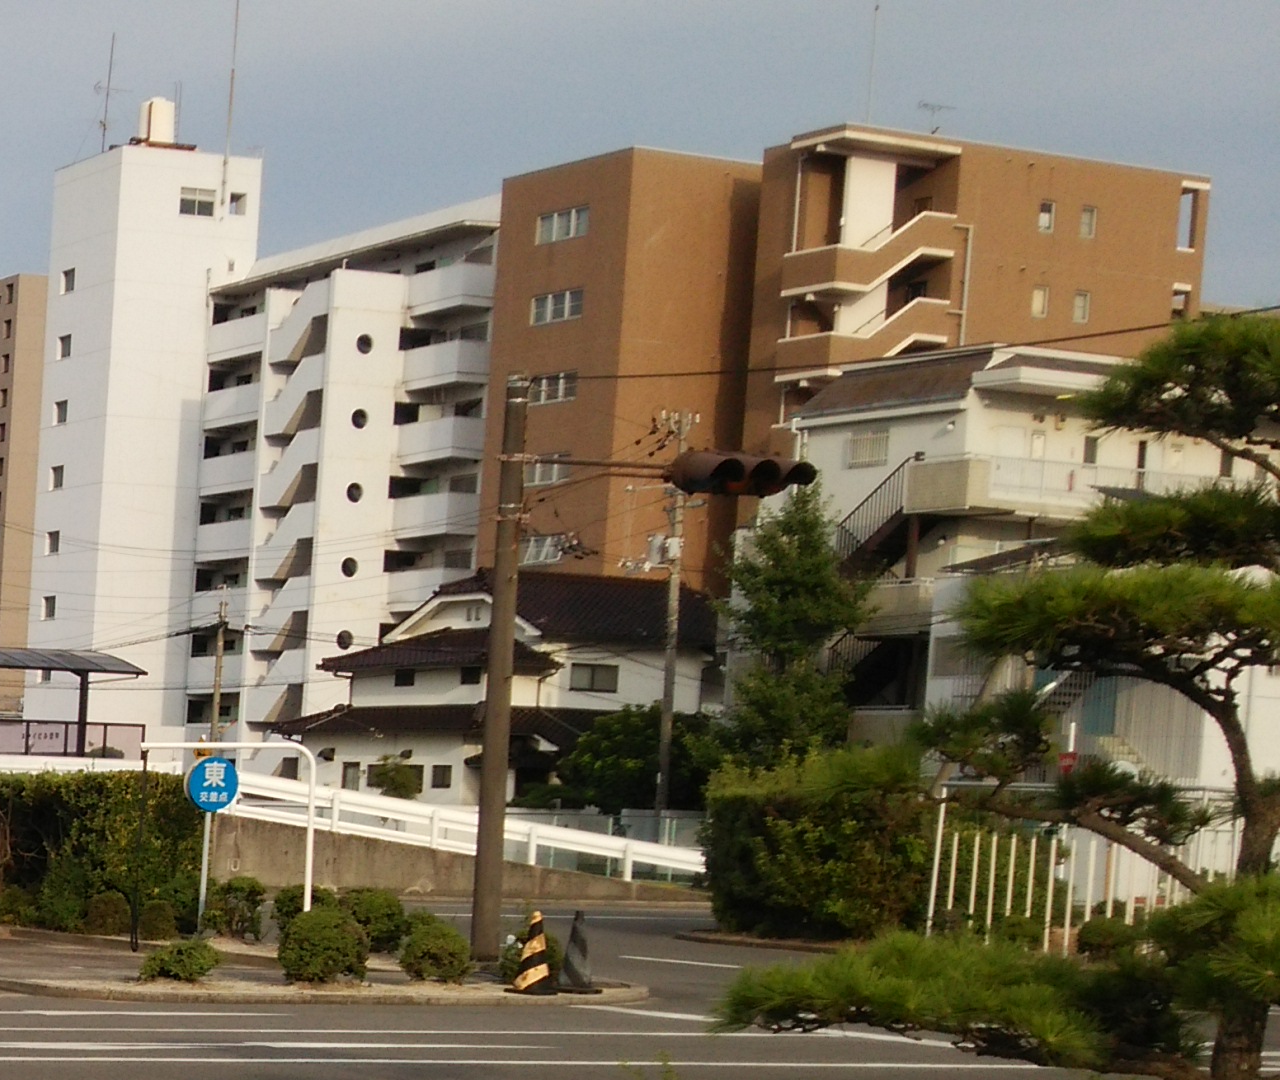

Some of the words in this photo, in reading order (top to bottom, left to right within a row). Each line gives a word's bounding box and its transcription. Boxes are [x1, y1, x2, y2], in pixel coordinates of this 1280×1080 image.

[202, 761, 227, 787] 東
[199, 791, 228, 802] 交差点
